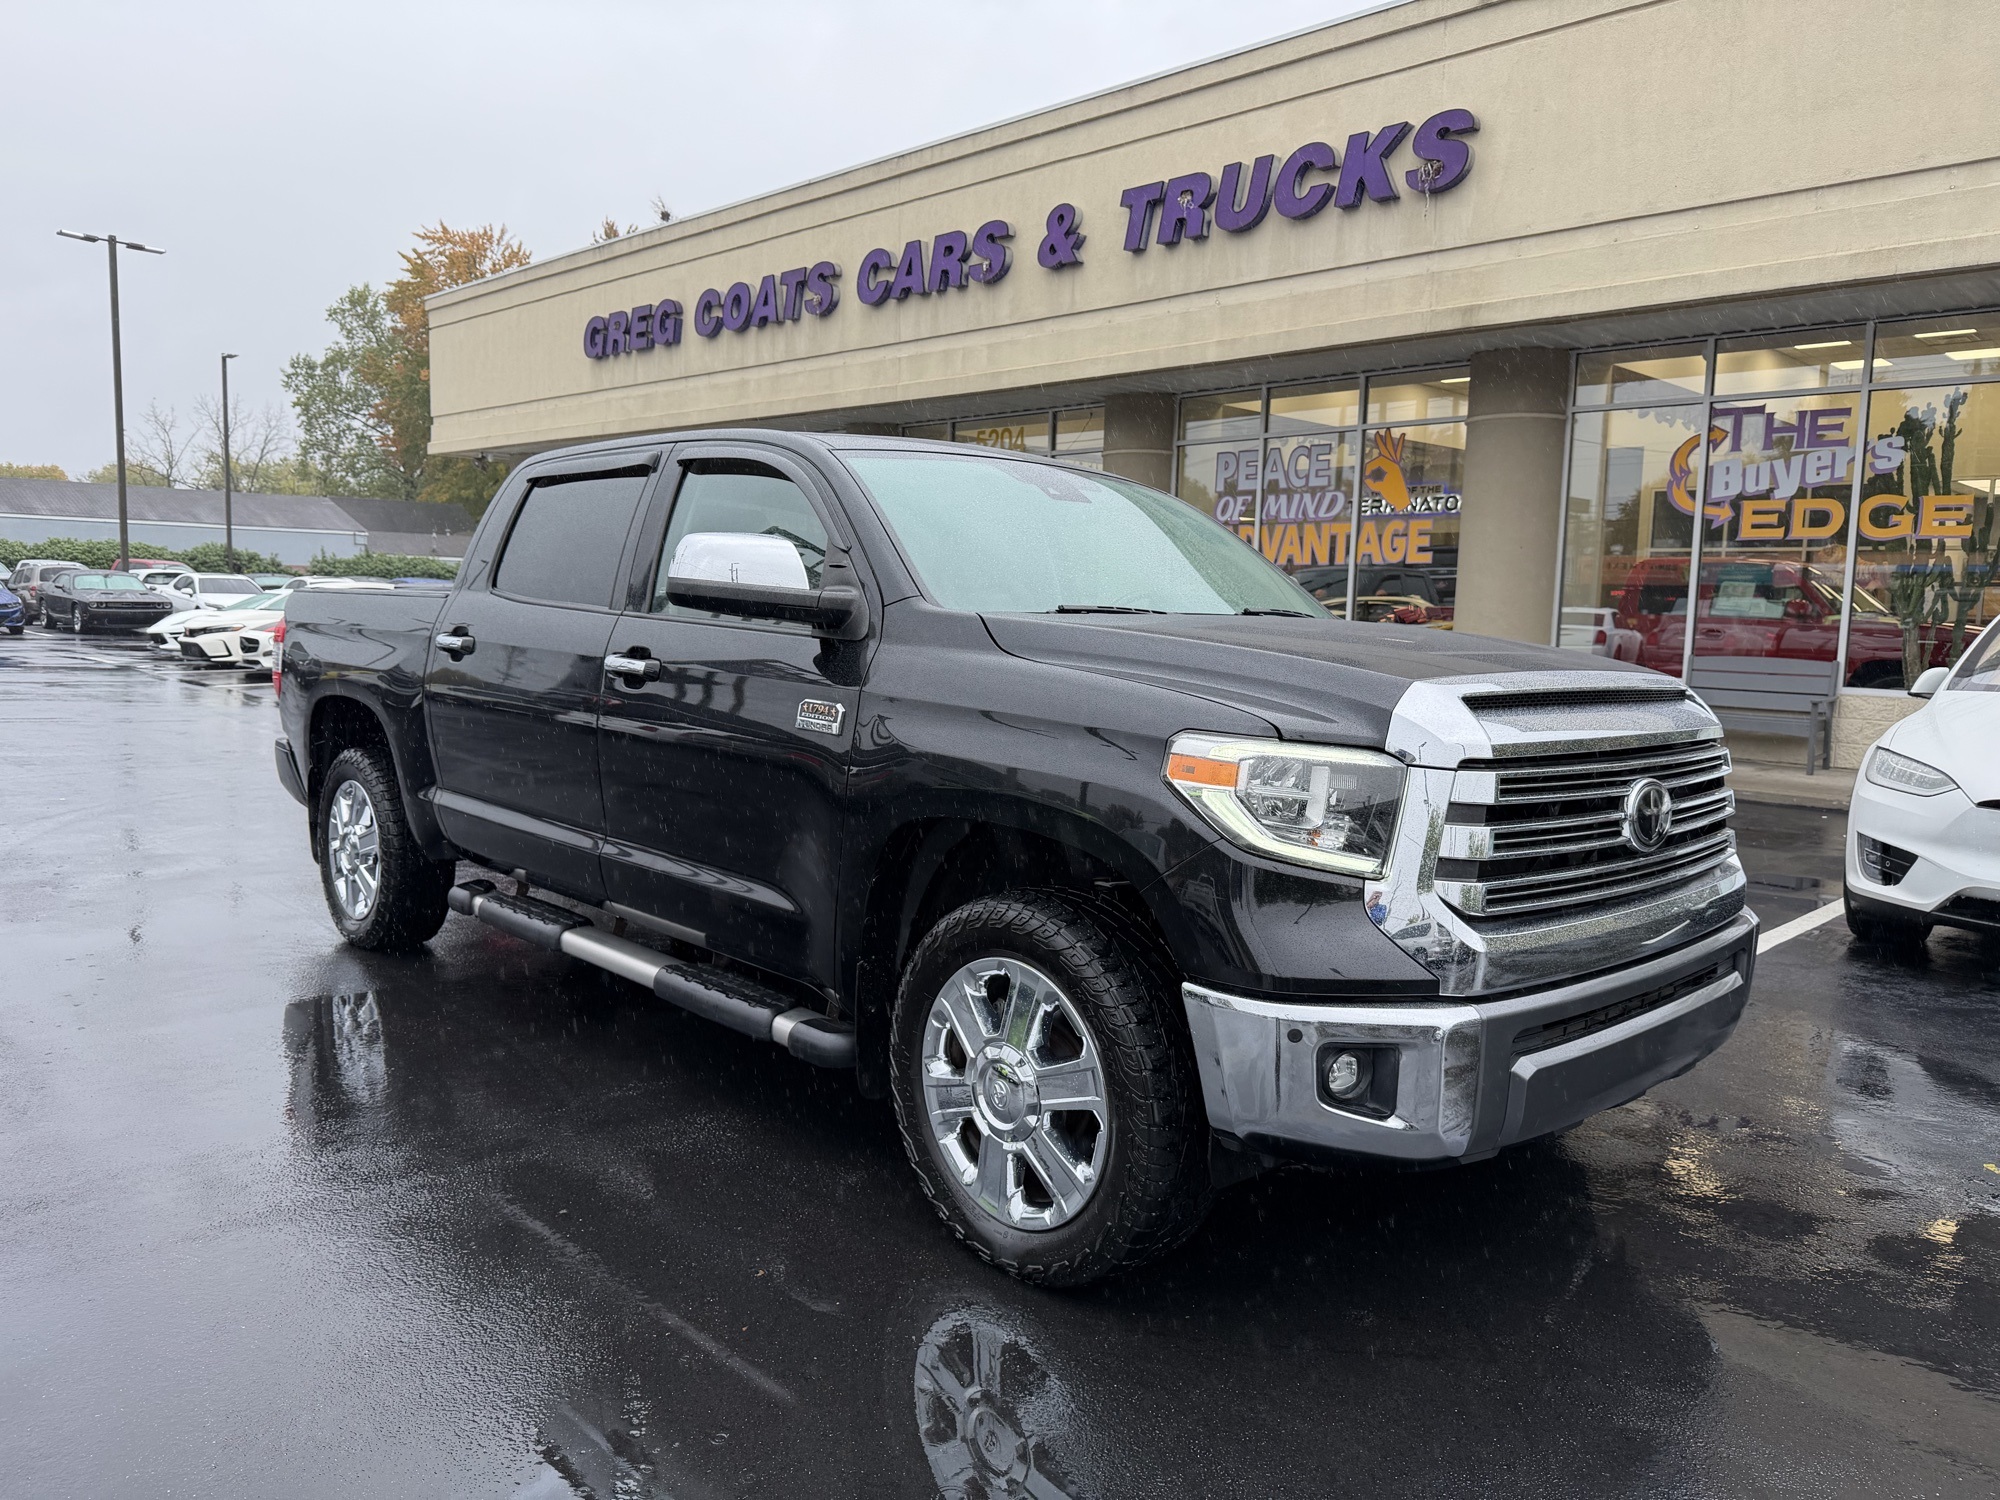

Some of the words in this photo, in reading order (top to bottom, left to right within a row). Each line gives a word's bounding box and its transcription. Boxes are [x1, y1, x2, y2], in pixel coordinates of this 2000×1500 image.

[584, 299, 683, 359] GREG
[695, 261, 841, 338] COATS
[857, 219, 1015, 306] CARS
[1038, 203, 1086, 269] &
[1119, 108, 1480, 254] TRUCKS
[976, 426, 1026, 452] 5204
[1711, 403, 1852, 453] THE
[1215, 443, 1332, 493] PEACE
[1420, 485, 1442, 494] THE
[1214, 494, 1254, 524] OF
[1261, 490, 1346, 524] MIND
[1735, 494, 1975, 541] EDGE
[801, 711, 835, 721] EDITION
[808, 703, 830, 715] 1794
